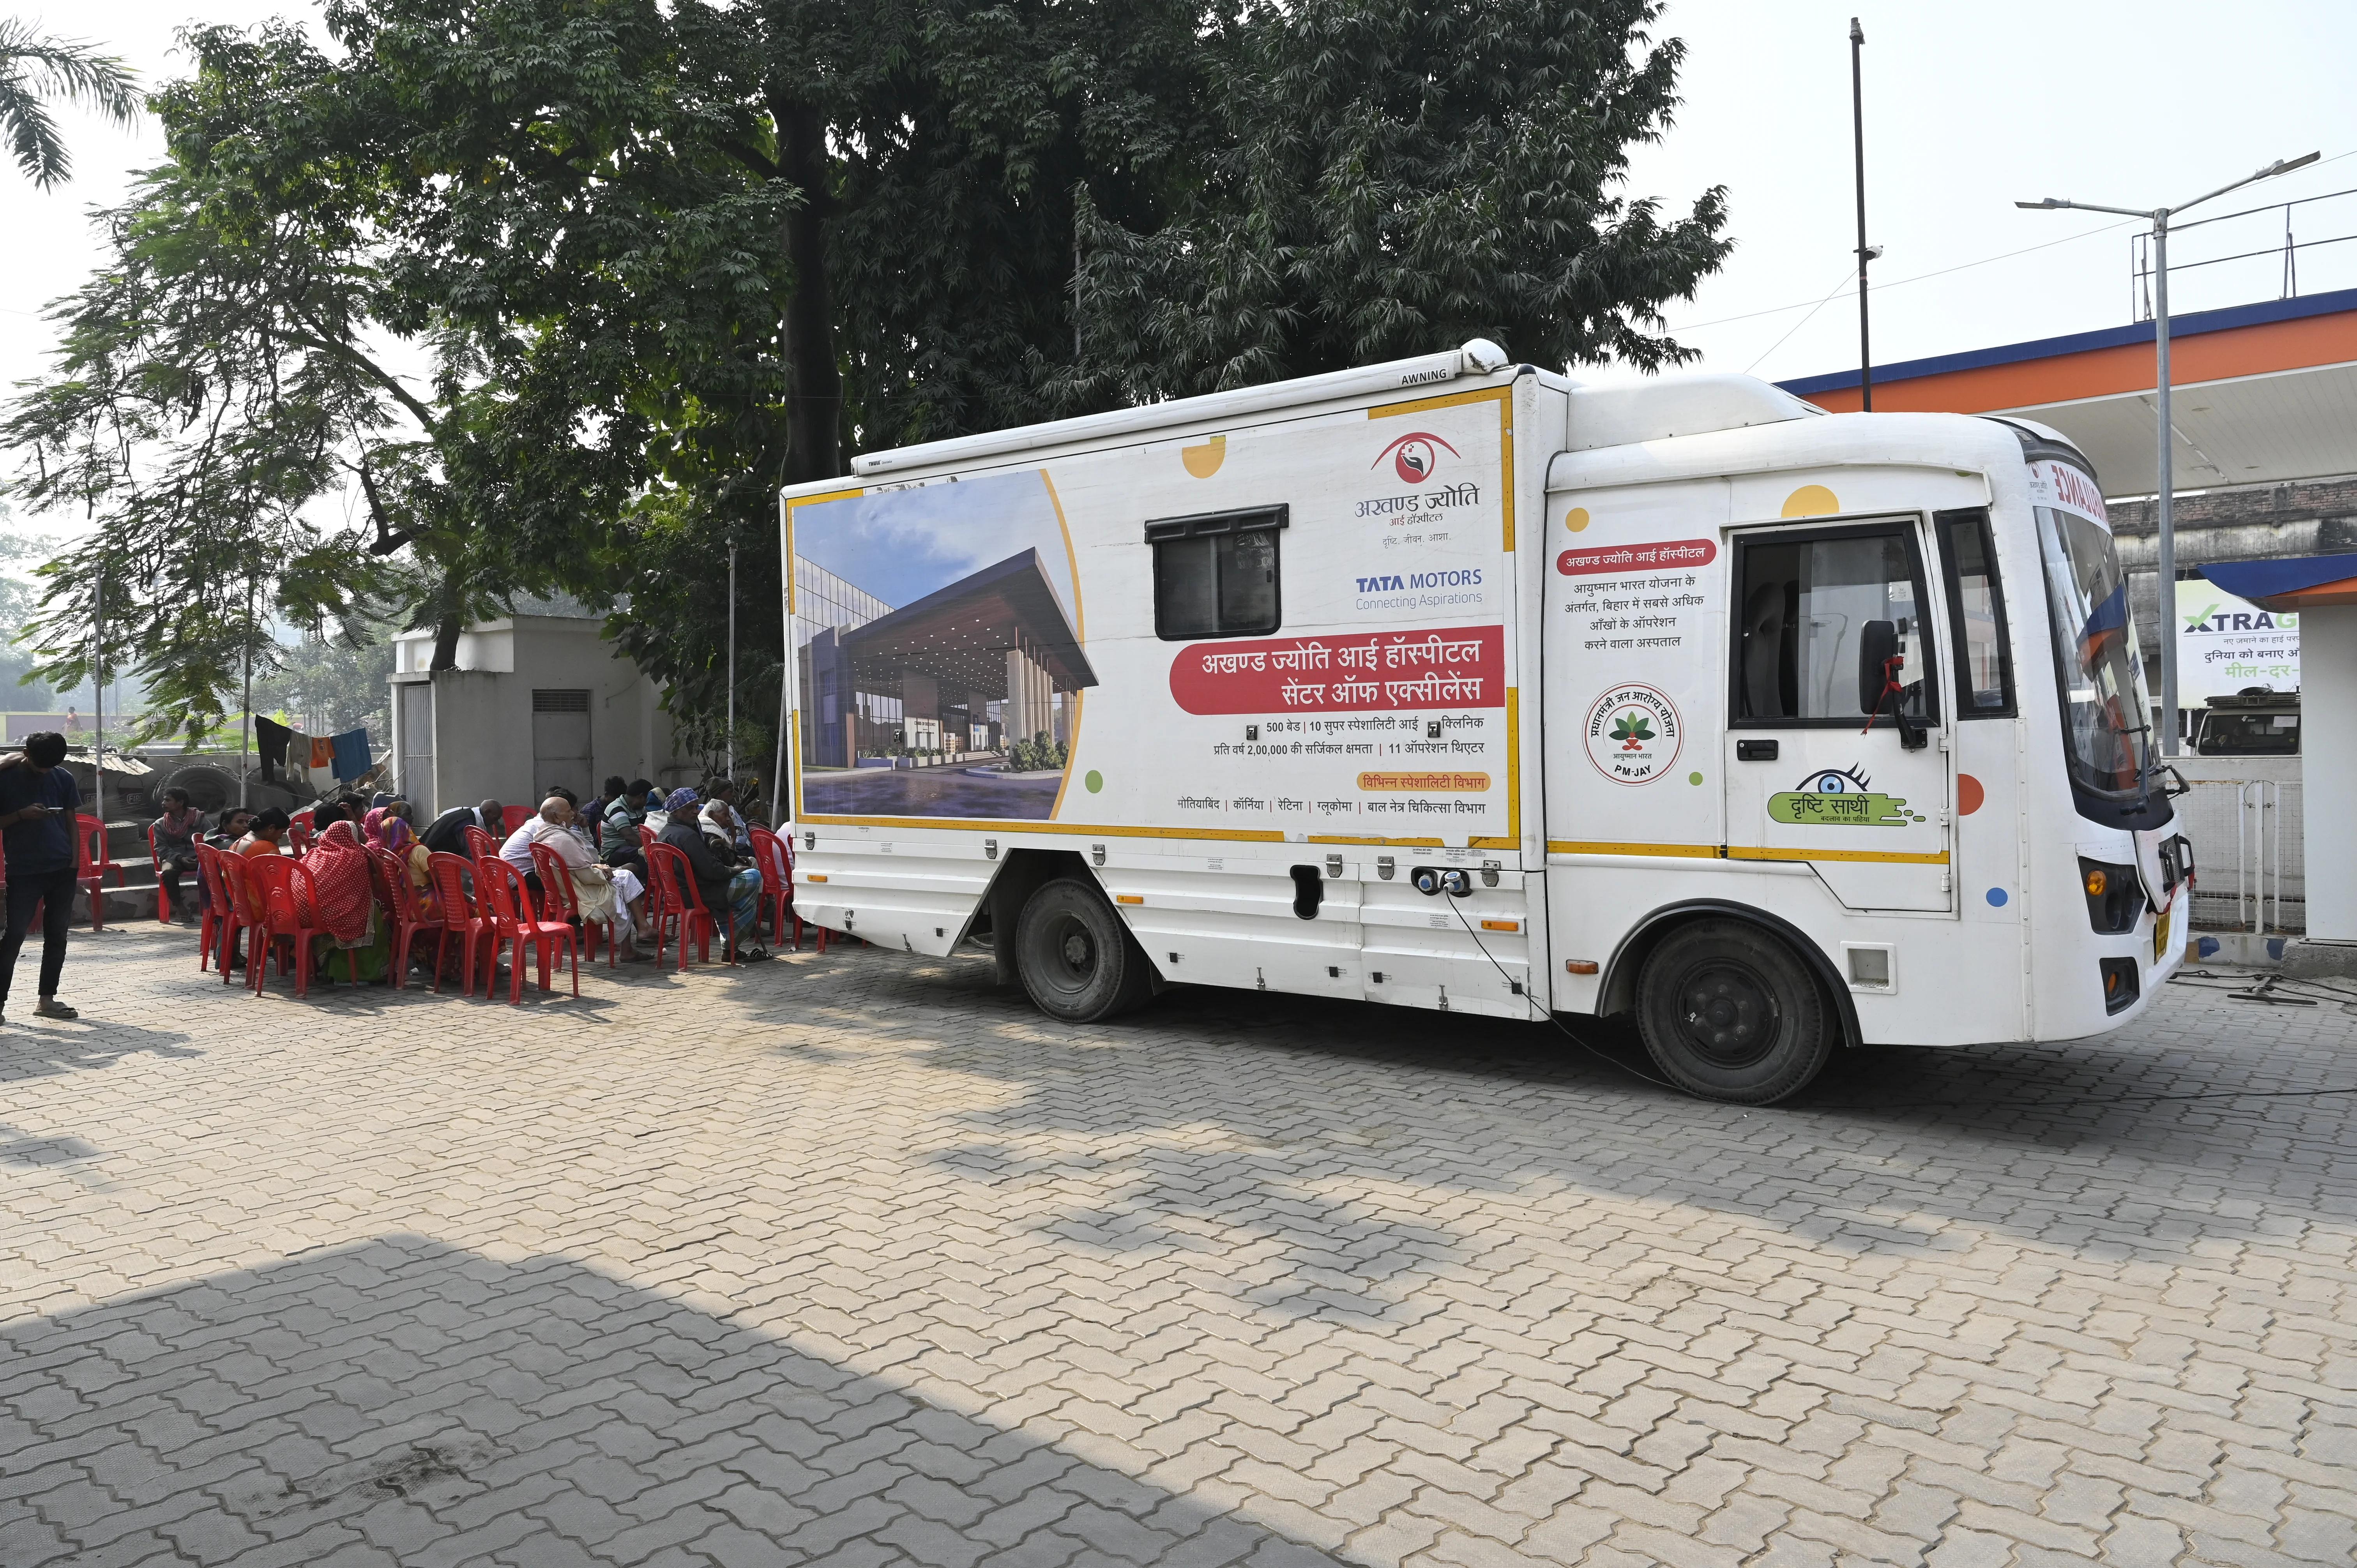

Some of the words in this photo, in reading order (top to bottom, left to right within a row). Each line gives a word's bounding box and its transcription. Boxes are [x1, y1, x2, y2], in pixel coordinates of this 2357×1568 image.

[1402, 369, 1446, 385] AWNING
[1355, 495, 1419, 517] अखण्ड
[1424, 482, 1480, 509] ज्योति
[1389, 515, 1405, 526] आई
[1407, 512, 1443, 525] हॉस्पीटल
[1566, 556, 1600, 567] अखण्ड
[1603, 551, 1633, 563] ज्योति
[1636, 548, 1657, 563] आई
[1659, 546, 1705, 561] हॉस्पीटल
[1356, 576, 1405, 593] TATA
[1410, 569, 1482, 589] MOTORS
[1574, 582, 1617, 597] आयुष्मान
[1620, 580, 1646, 590] भारत
[1649, 576, 1682, 588] योजना
[1685, 574, 1696, 586] के
[1357, 596, 1416, 610] Connecting
[1419, 592, 1482, 607] Aspirations
[1565, 600, 1599, 613] अंतर्गत,
[1603, 599, 1629, 611] बिहार
[1632, 597, 1640, 609] में
[1643, 595, 1669, 608] सबसे
[1672, 594, 1704, 607] अधिक
[1590, 617, 1617, 630] आँखों
[1620, 617, 1629, 629] के
[1633, 615, 1677, 628] ऑपरेशन
[1585, 637, 1607, 650] करने
[1610, 639, 1634, 649] वाला
[1637, 637, 1681, 647] अस्पताल
[2272, 635, 2284, 643] हाई
[1202, 652, 1267, 674] अखण्ड
[1271, 641, 1332, 670] ज्योति
[1338, 638, 1379, 671] आई
[1384, 634, 1482, 668] हॉस्पीटल
[2204, 650, 2235, 663] दुनिया
[2239, 648, 2253, 659] को
[2257, 650, 2284, 659] बनाए
[1281, 676, 1326, 705] सेंटर
[1331, 675, 1379, 703] ऑफ
[1385, 670, 1483, 706] एक्सीलेंस
[1591, 697, 1615, 737] प्रधानमंत्री
[1615, 692, 1631, 702] जन
[1632, 692, 1662, 710] आरोग्य
[1661, 707, 1674, 737] योजना
[1267, 722, 1283, 732] 500
[1286, 719, 1300, 731] बेड
[1309, 721, 1321, 731] 10
[1324, 721, 1345, 735] सुपर
[1348, 717, 1396, 731] स्पेशालिटी
[1399, 716, 1419, 731] आई
[1442, 715, 1484, 729] क्लिनिक
[1214, 742, 1230, 755] प्रति
[1233, 743, 1245, 755] वर्ष
[1247, 745, 1286, 756] 2,00,000
[1290, 742, 1302, 754] की
[1305, 742, 1343, 754] सर्जिकल
[1346, 744, 1373, 754] क्षमता
[1389, 743, 1400, 753] 11
[1405, 740, 1449, 754] ऑपरेशन
[1451, 740, 1484, 755] थिएटर
[1615, 765, 1651, 776] PM-JAY
[1363, 774, 1398, 788] विभिन्न
[1401, 774, 1451, 788] स्पेशालिटी
[1454, 775, 1486, 788] विभाग
[1177, 796, 1220, 809] मोतियाबिंद
[1233, 797, 1264, 810] कॉर्निया
[1278, 797, 1303, 811] रेटिना
[1317, 798, 1352, 816] ग्लूकोमा
[1368, 802, 1387, 812] बाल
[1390, 799, 1405, 812] नेत्र
[1408, 799, 1451, 813] चिकित्सा
[1454, 800, 1486, 814] विभाग
[1789, 794, 1824, 819] दृष्टि
[1829, 795, 1869, 815] साथी
